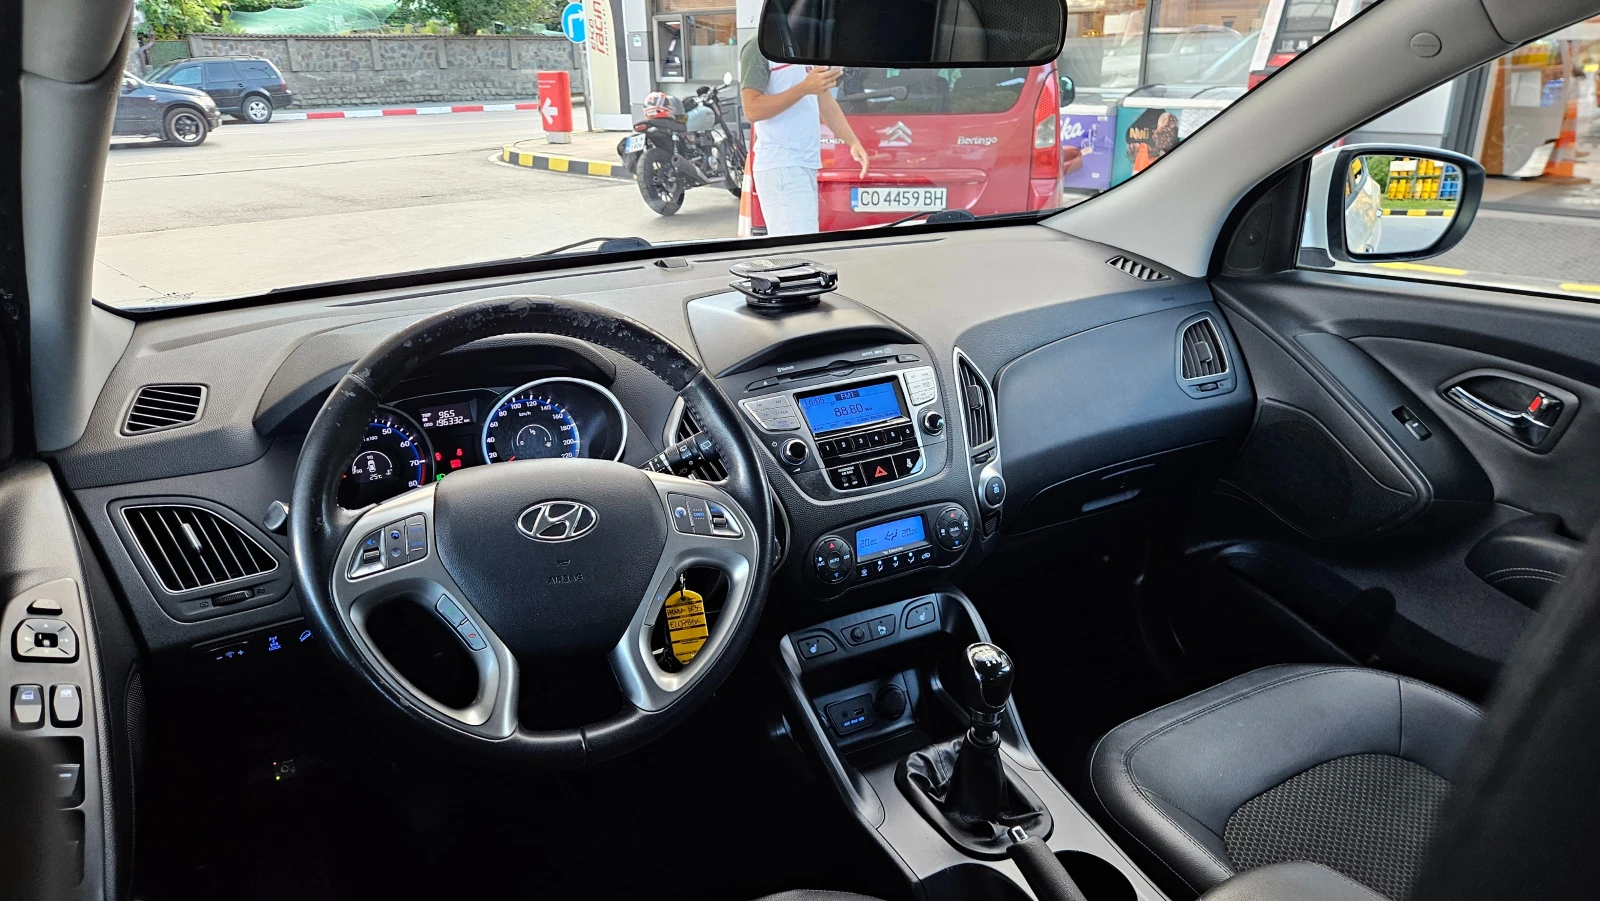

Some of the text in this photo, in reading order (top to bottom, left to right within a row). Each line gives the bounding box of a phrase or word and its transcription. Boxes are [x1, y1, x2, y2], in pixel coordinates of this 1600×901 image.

[1060, 117, 1085, 141] ka
[957, 136, 998, 146] Berlingo
[860, 190, 944, 206] CO 4459 BH
[840, 391, 855, 400] FM1
[834, 403, 863, 417] 88.80
[436, 416, 464, 427] 196332
[400, 440, 410, 448] 60
